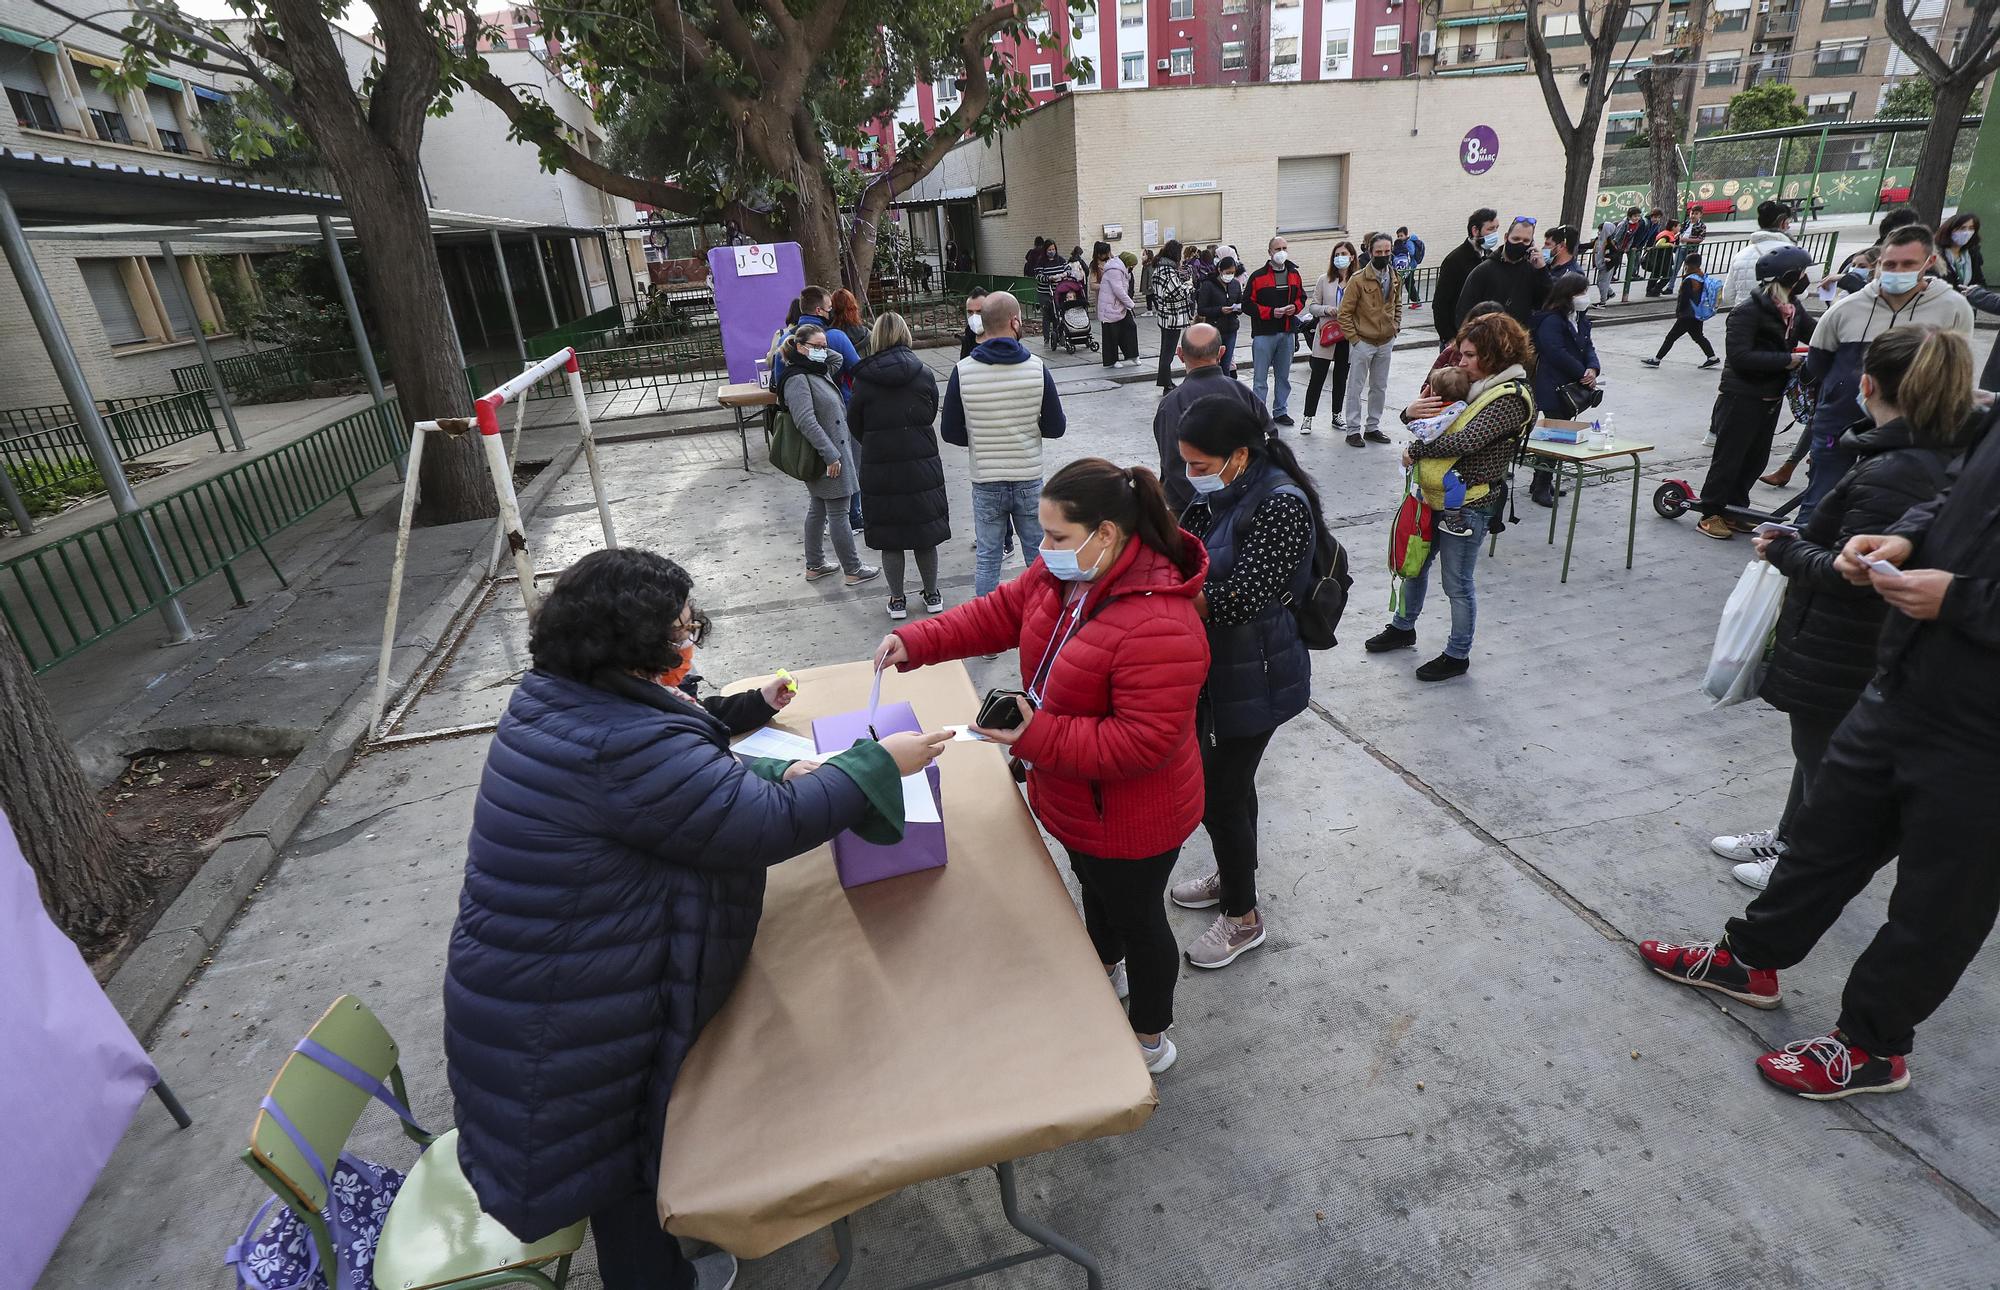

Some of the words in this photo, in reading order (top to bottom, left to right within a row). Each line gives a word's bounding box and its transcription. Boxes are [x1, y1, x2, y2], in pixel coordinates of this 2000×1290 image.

[1467, 138, 1480, 164] 8
[1479, 153, 1495, 163] MARÇ
[738, 254, 746, 269] J
[762, 252, 775, 269] Q
